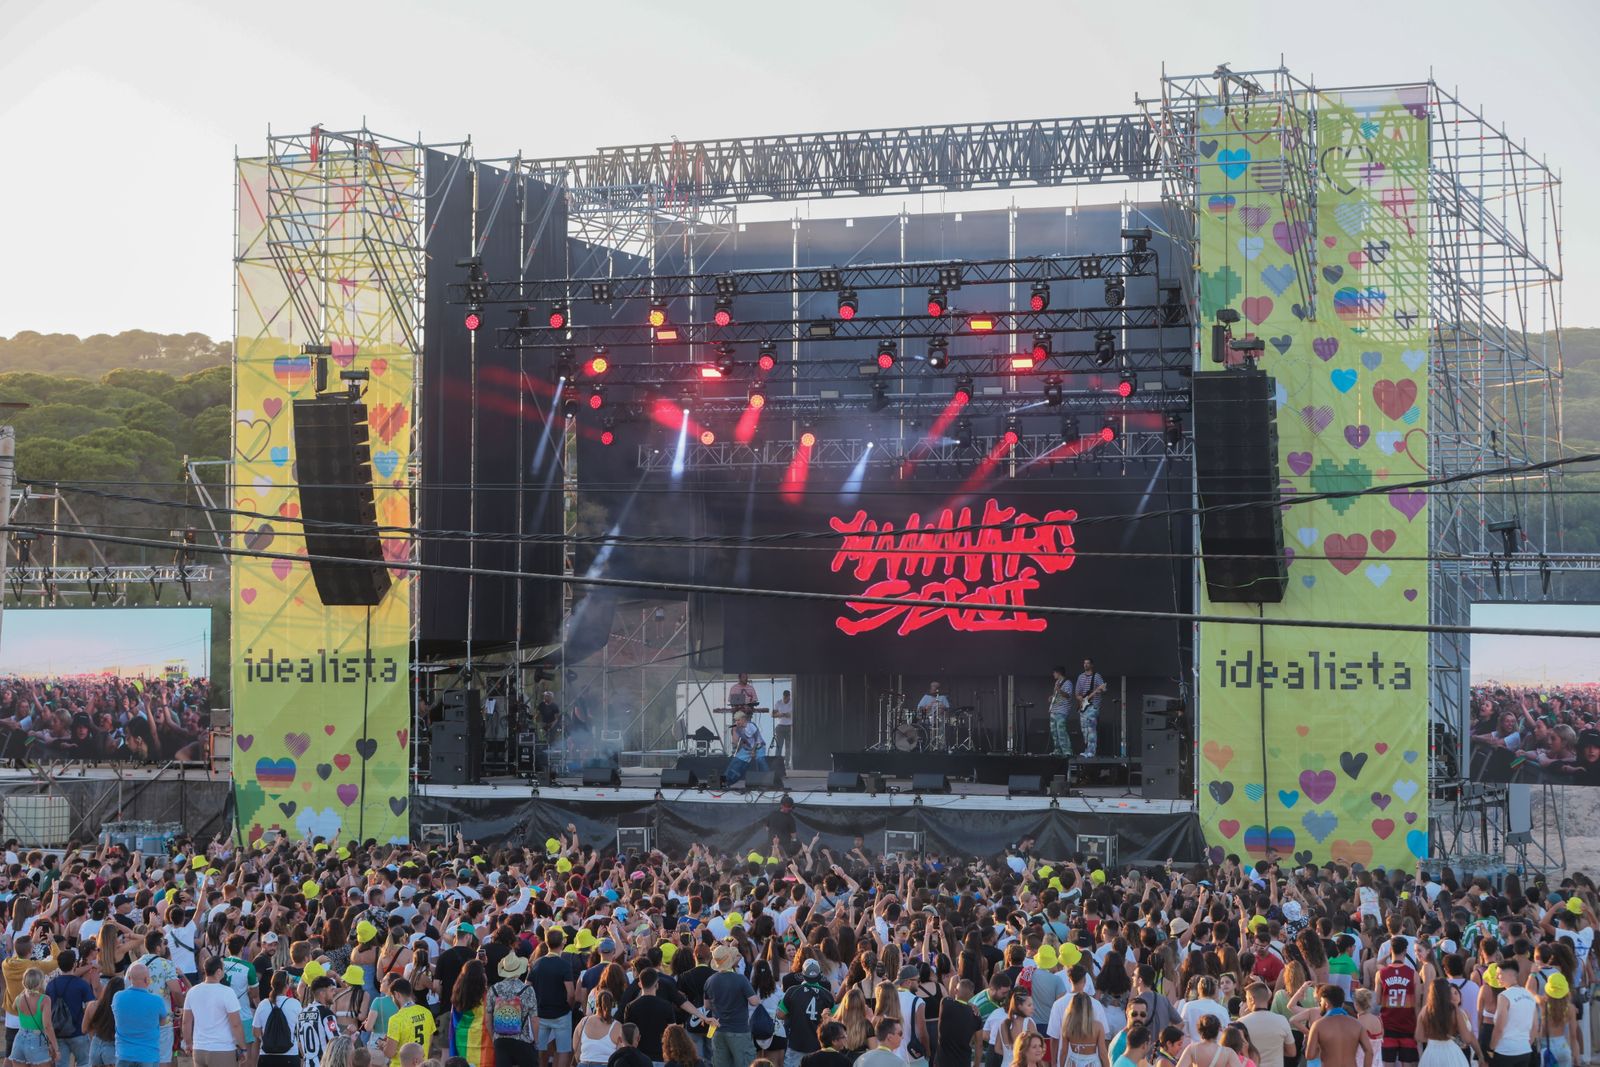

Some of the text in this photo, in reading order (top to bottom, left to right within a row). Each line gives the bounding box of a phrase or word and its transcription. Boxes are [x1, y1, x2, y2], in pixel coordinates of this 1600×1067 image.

[243, 648, 397, 683] idealista
[1216, 649, 1411, 690] idealista
[1385, 976, 1410, 986] MURRAY
[806, 996, 818, 1020] 4
[1389, 989, 1406, 1007] 27
[299, 1021, 320, 1059] 10
[415, 1024, 424, 1045] 5
